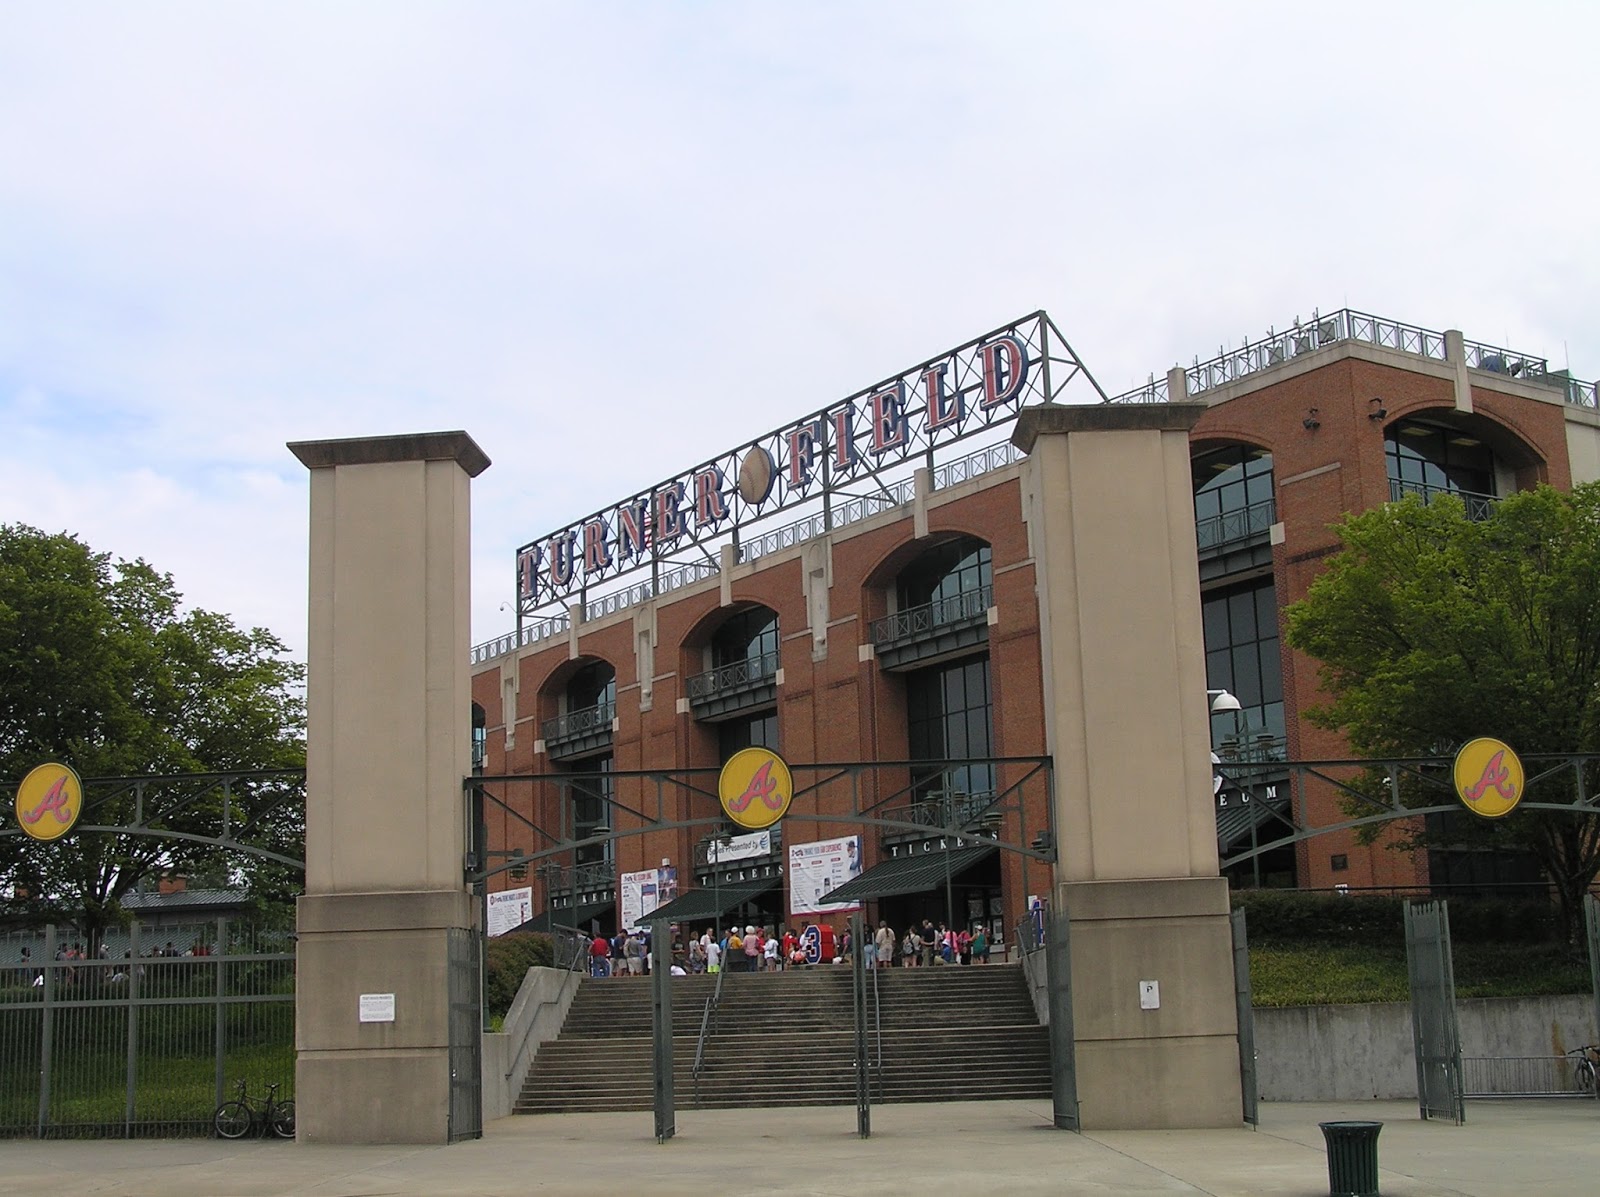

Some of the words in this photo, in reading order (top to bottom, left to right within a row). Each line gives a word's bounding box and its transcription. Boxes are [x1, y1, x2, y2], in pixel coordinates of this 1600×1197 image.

[517, 466, 730, 601] TURNER
[785, 334, 1030, 492] FIELD
[23, 774, 72, 825] A
[729, 759, 783, 813] A
[1464, 749, 1515, 802] A
[701, 864, 784, 887] TCKETS
[801, 924, 822, 965] 3
